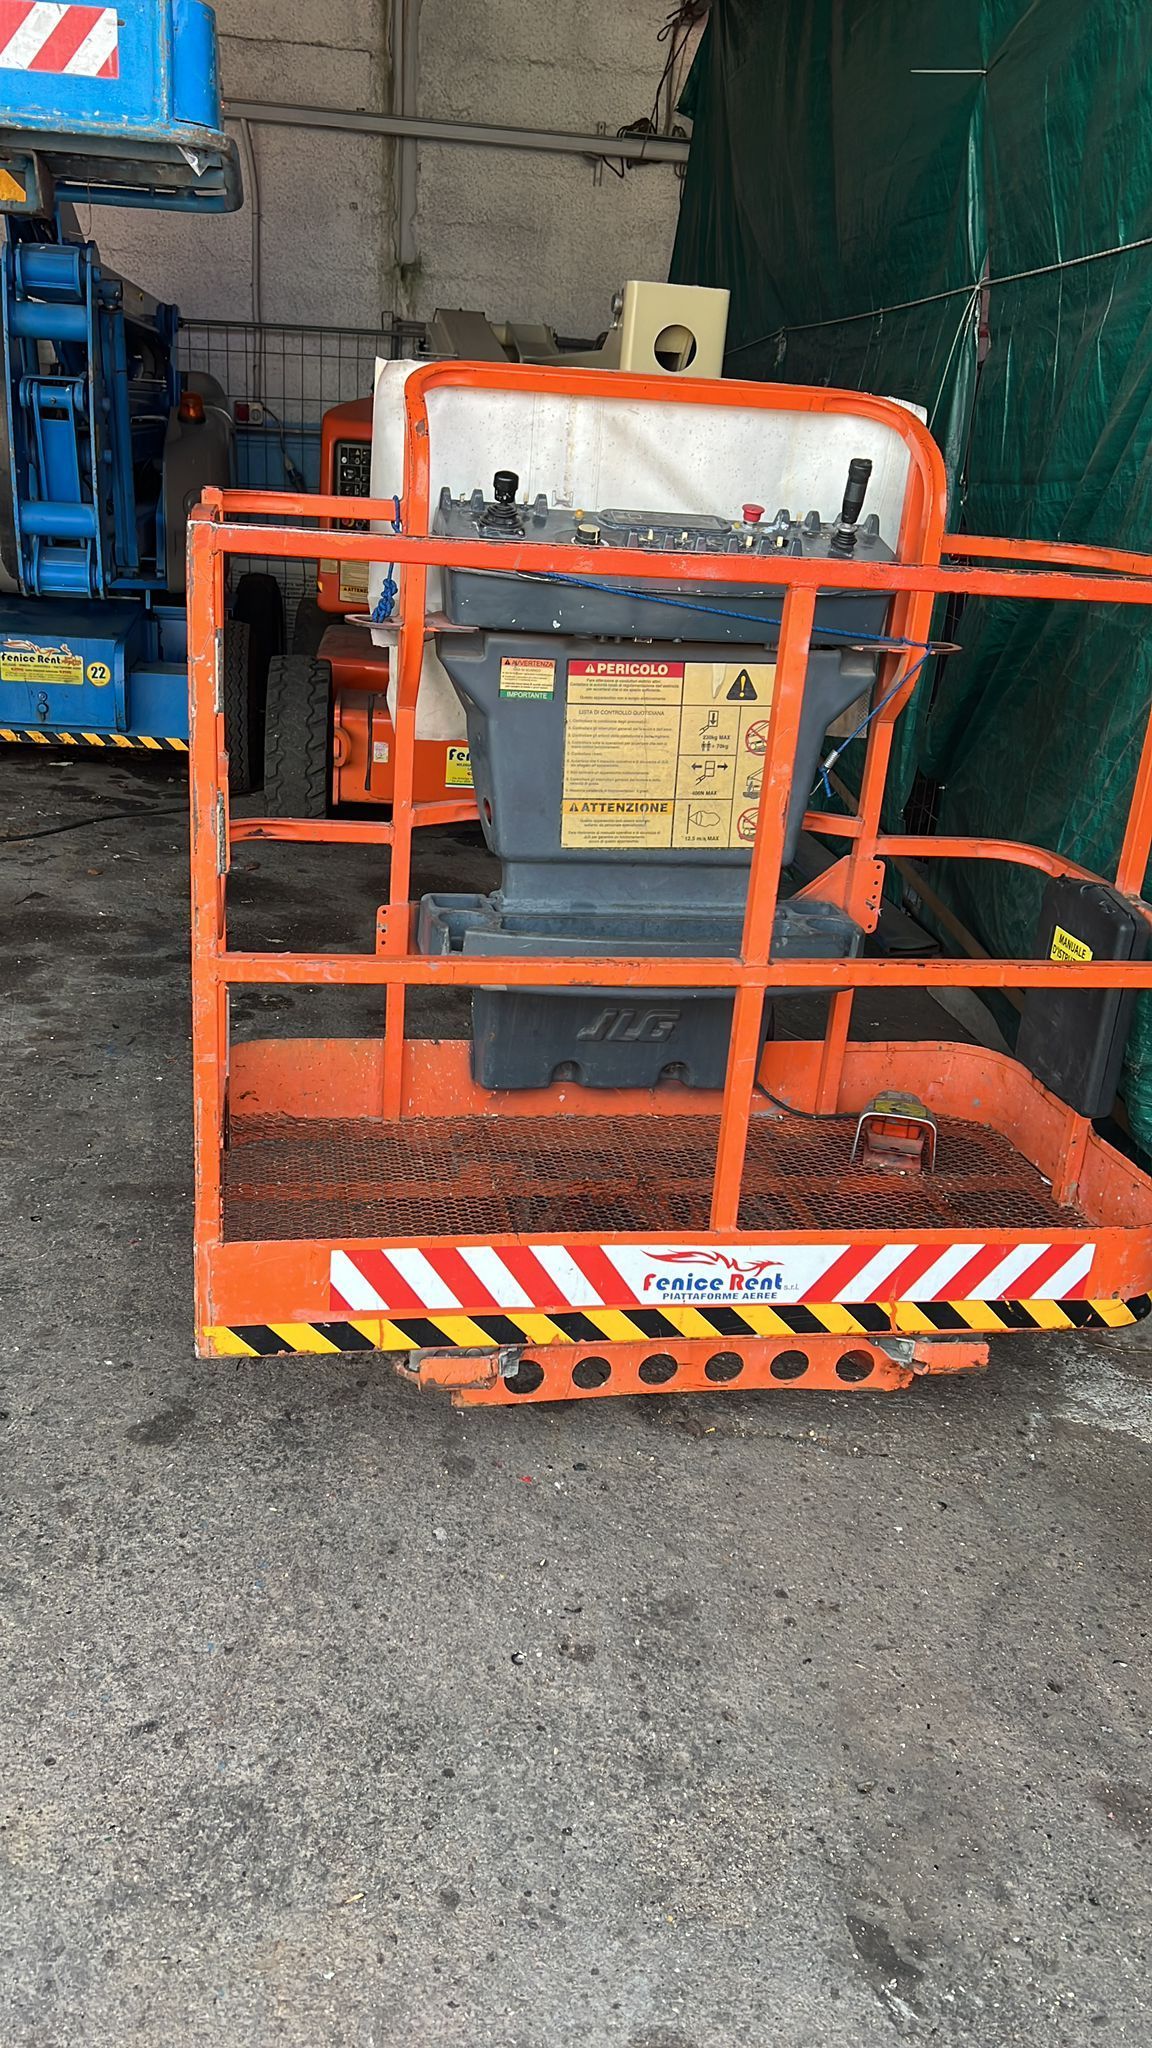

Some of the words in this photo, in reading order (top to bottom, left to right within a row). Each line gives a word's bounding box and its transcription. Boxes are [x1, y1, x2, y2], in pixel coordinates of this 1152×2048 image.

[1, 653, 35, 663] Fenice
[37, 655, 61, 664] Rent
[512, 660, 553, 668] AVVERTENZA
[91, 666, 106, 679] 22
[597, 663, 668, 675] PERICOLO
[506, 691, 548, 700] IMPORTANTE
[581, 802, 669, 813] ATTENZIONE
[1059, 933, 1087, 960] MANUALE
[577, 1008, 682, 1043] JLG
[643, 1272, 724, 1291] Fenice
[729, 1273, 783, 1291] Rent
[662, 1292, 739, 1300] PIATTAFORME
[742, 1291, 778, 1300] AEREE
